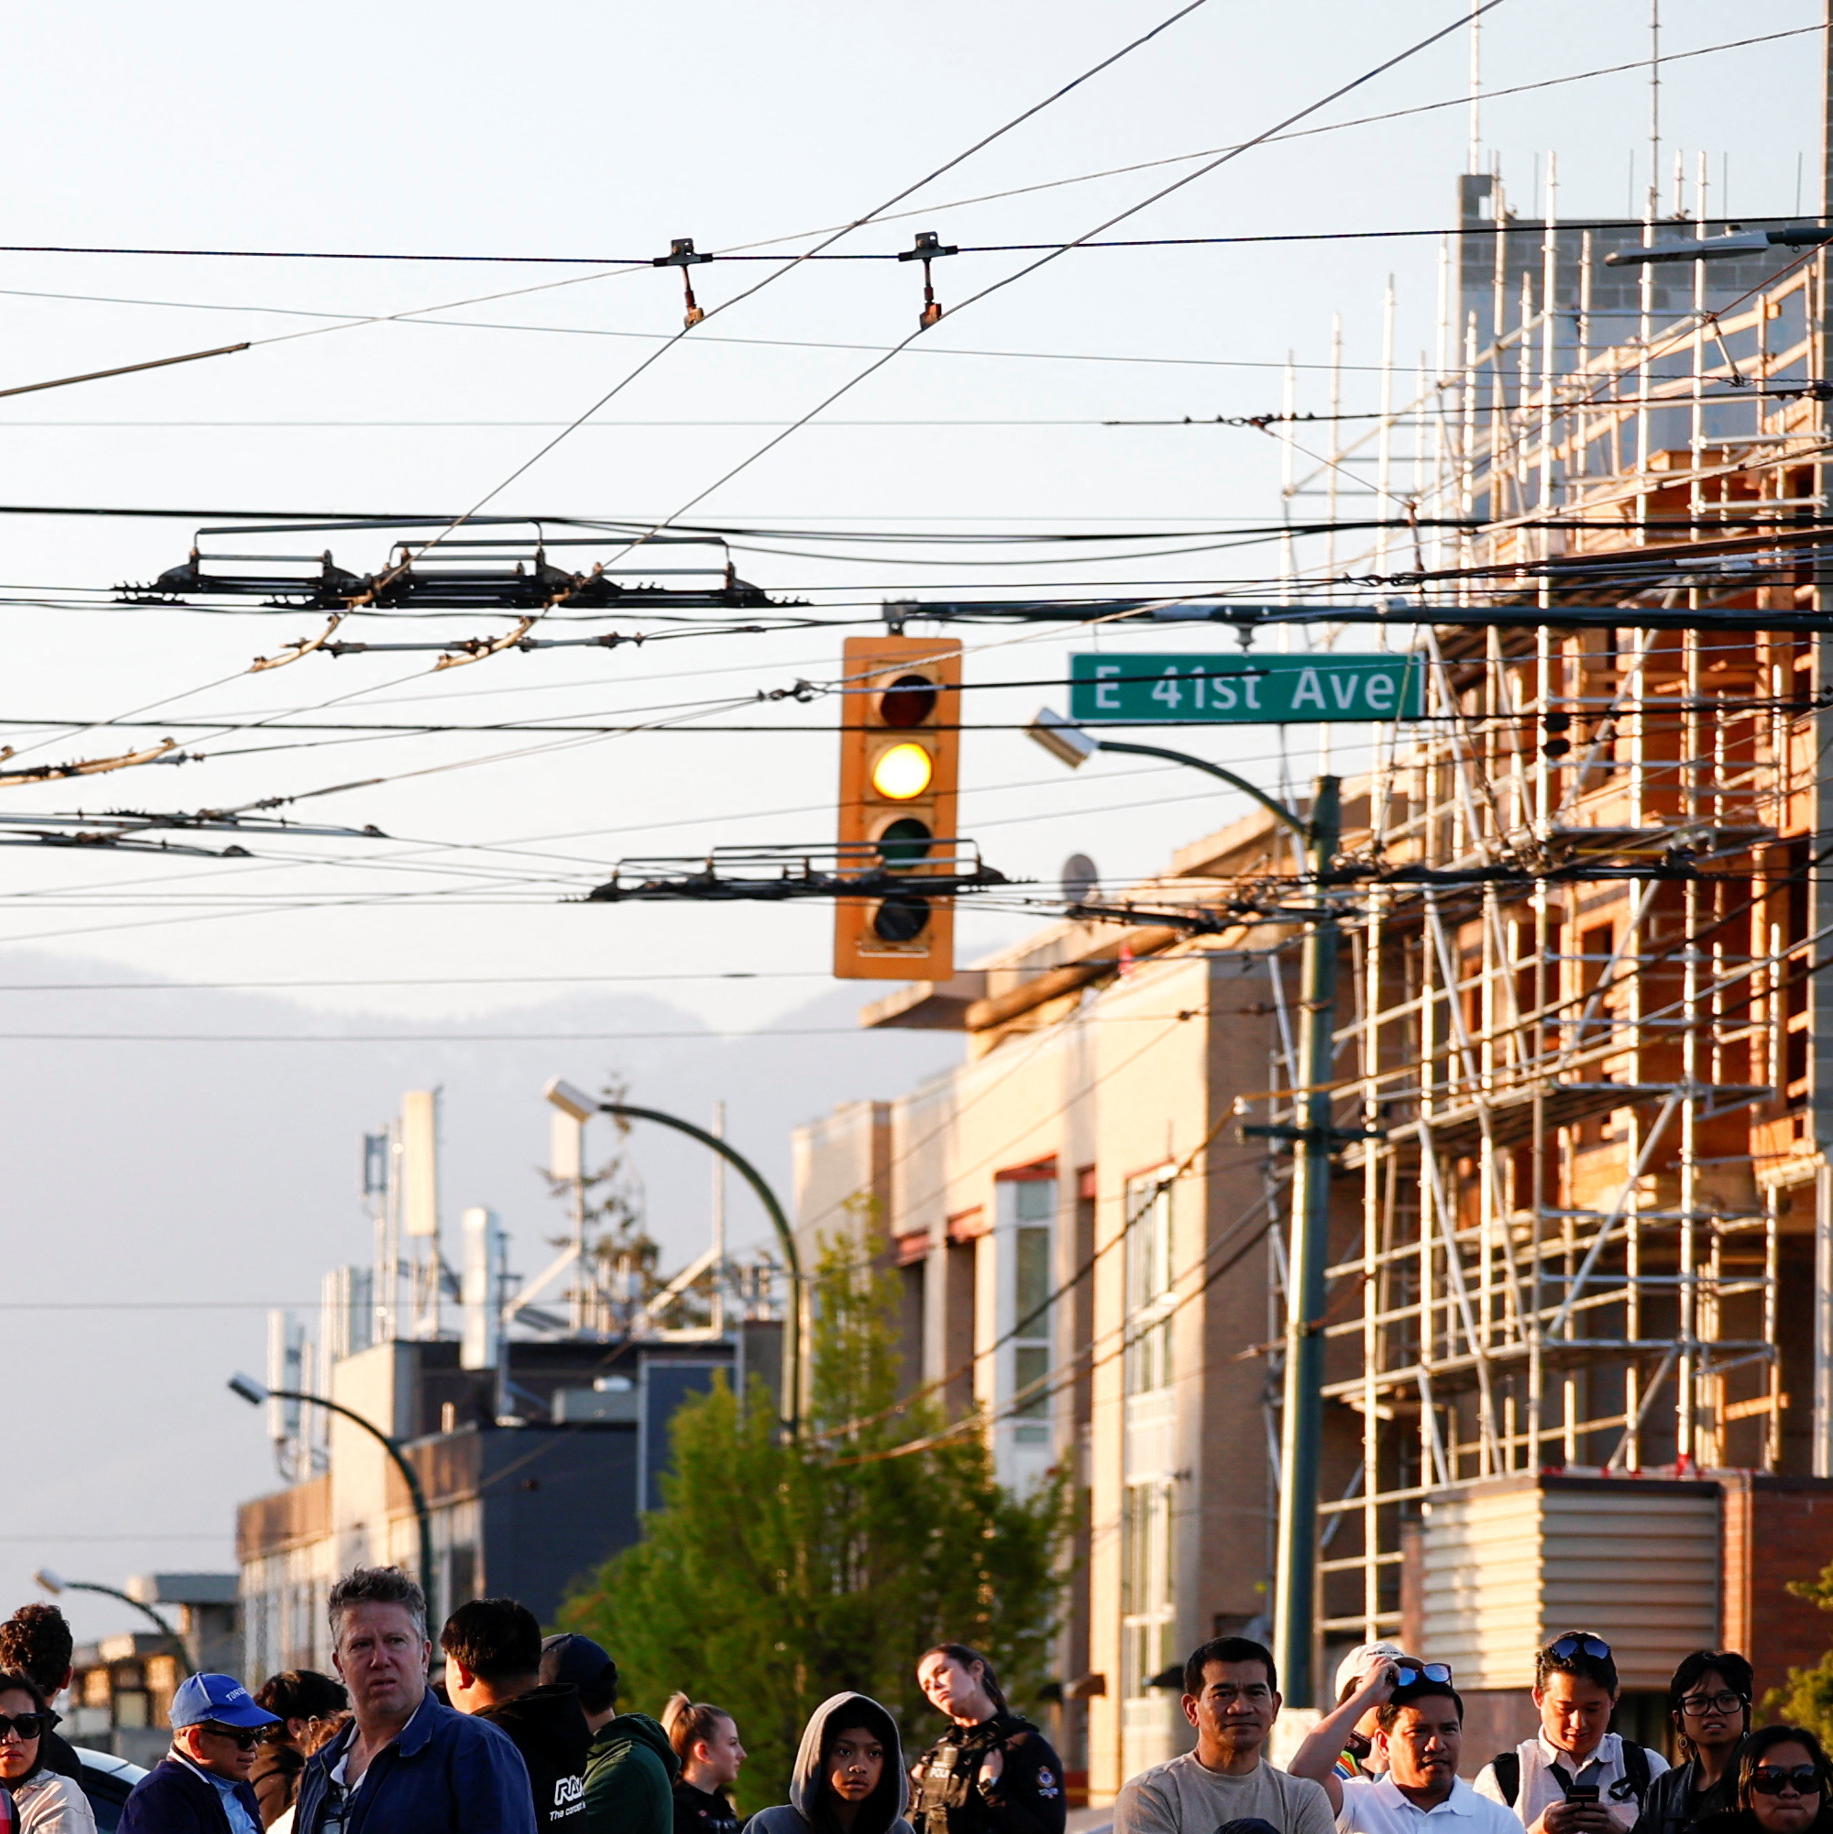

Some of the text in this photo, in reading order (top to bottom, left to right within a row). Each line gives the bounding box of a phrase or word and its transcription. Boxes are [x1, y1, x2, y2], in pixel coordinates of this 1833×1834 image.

[1095, 666, 1395, 710] E 41st Ave
